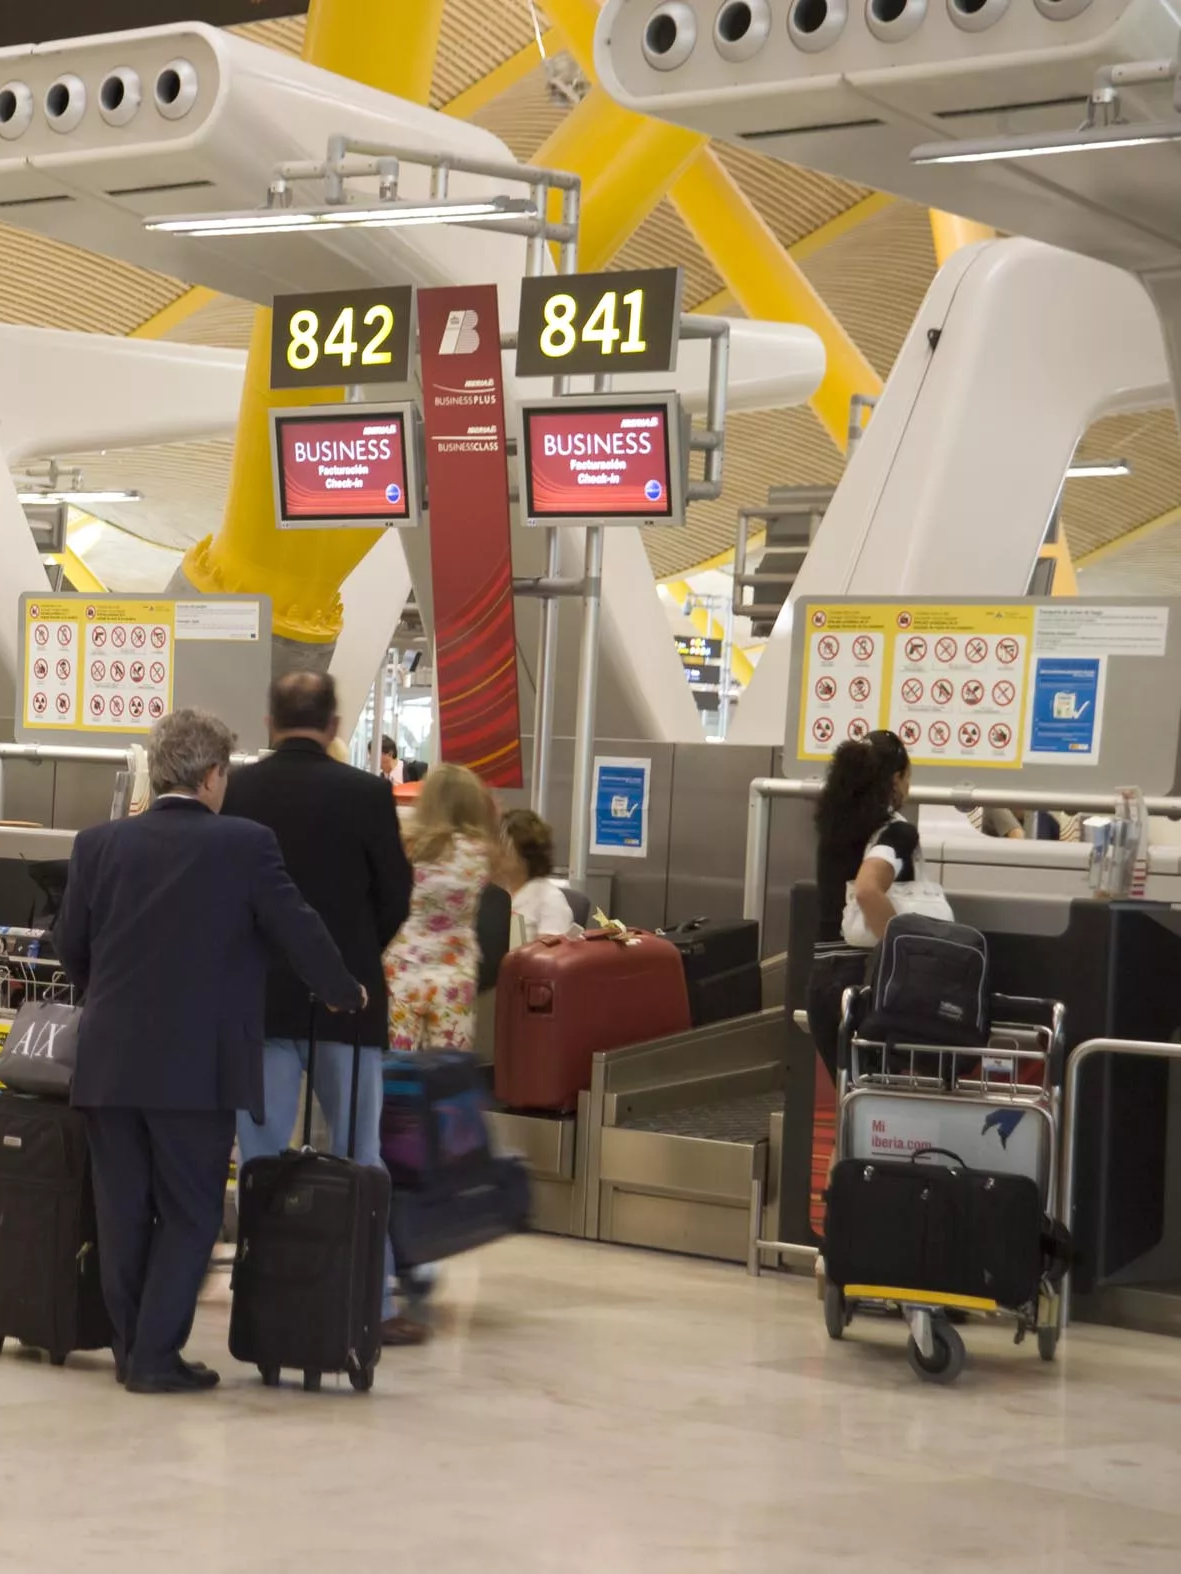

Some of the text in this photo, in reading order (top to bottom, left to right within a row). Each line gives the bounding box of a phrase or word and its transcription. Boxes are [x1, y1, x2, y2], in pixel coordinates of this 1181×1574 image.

[539, 289, 647, 357] 841
[286, 304, 394, 370] 842
[294, 439, 391, 463] BUSINESS
[544, 432, 652, 457] BUSINESS
[570, 458, 627, 472] Facturación
[577, 472, 620, 485] Check-in
[11, 1020, 67, 1059] A/X
[871, 1119, 886, 1133] Mi
[871, 1135, 932, 1152] iberia.com
